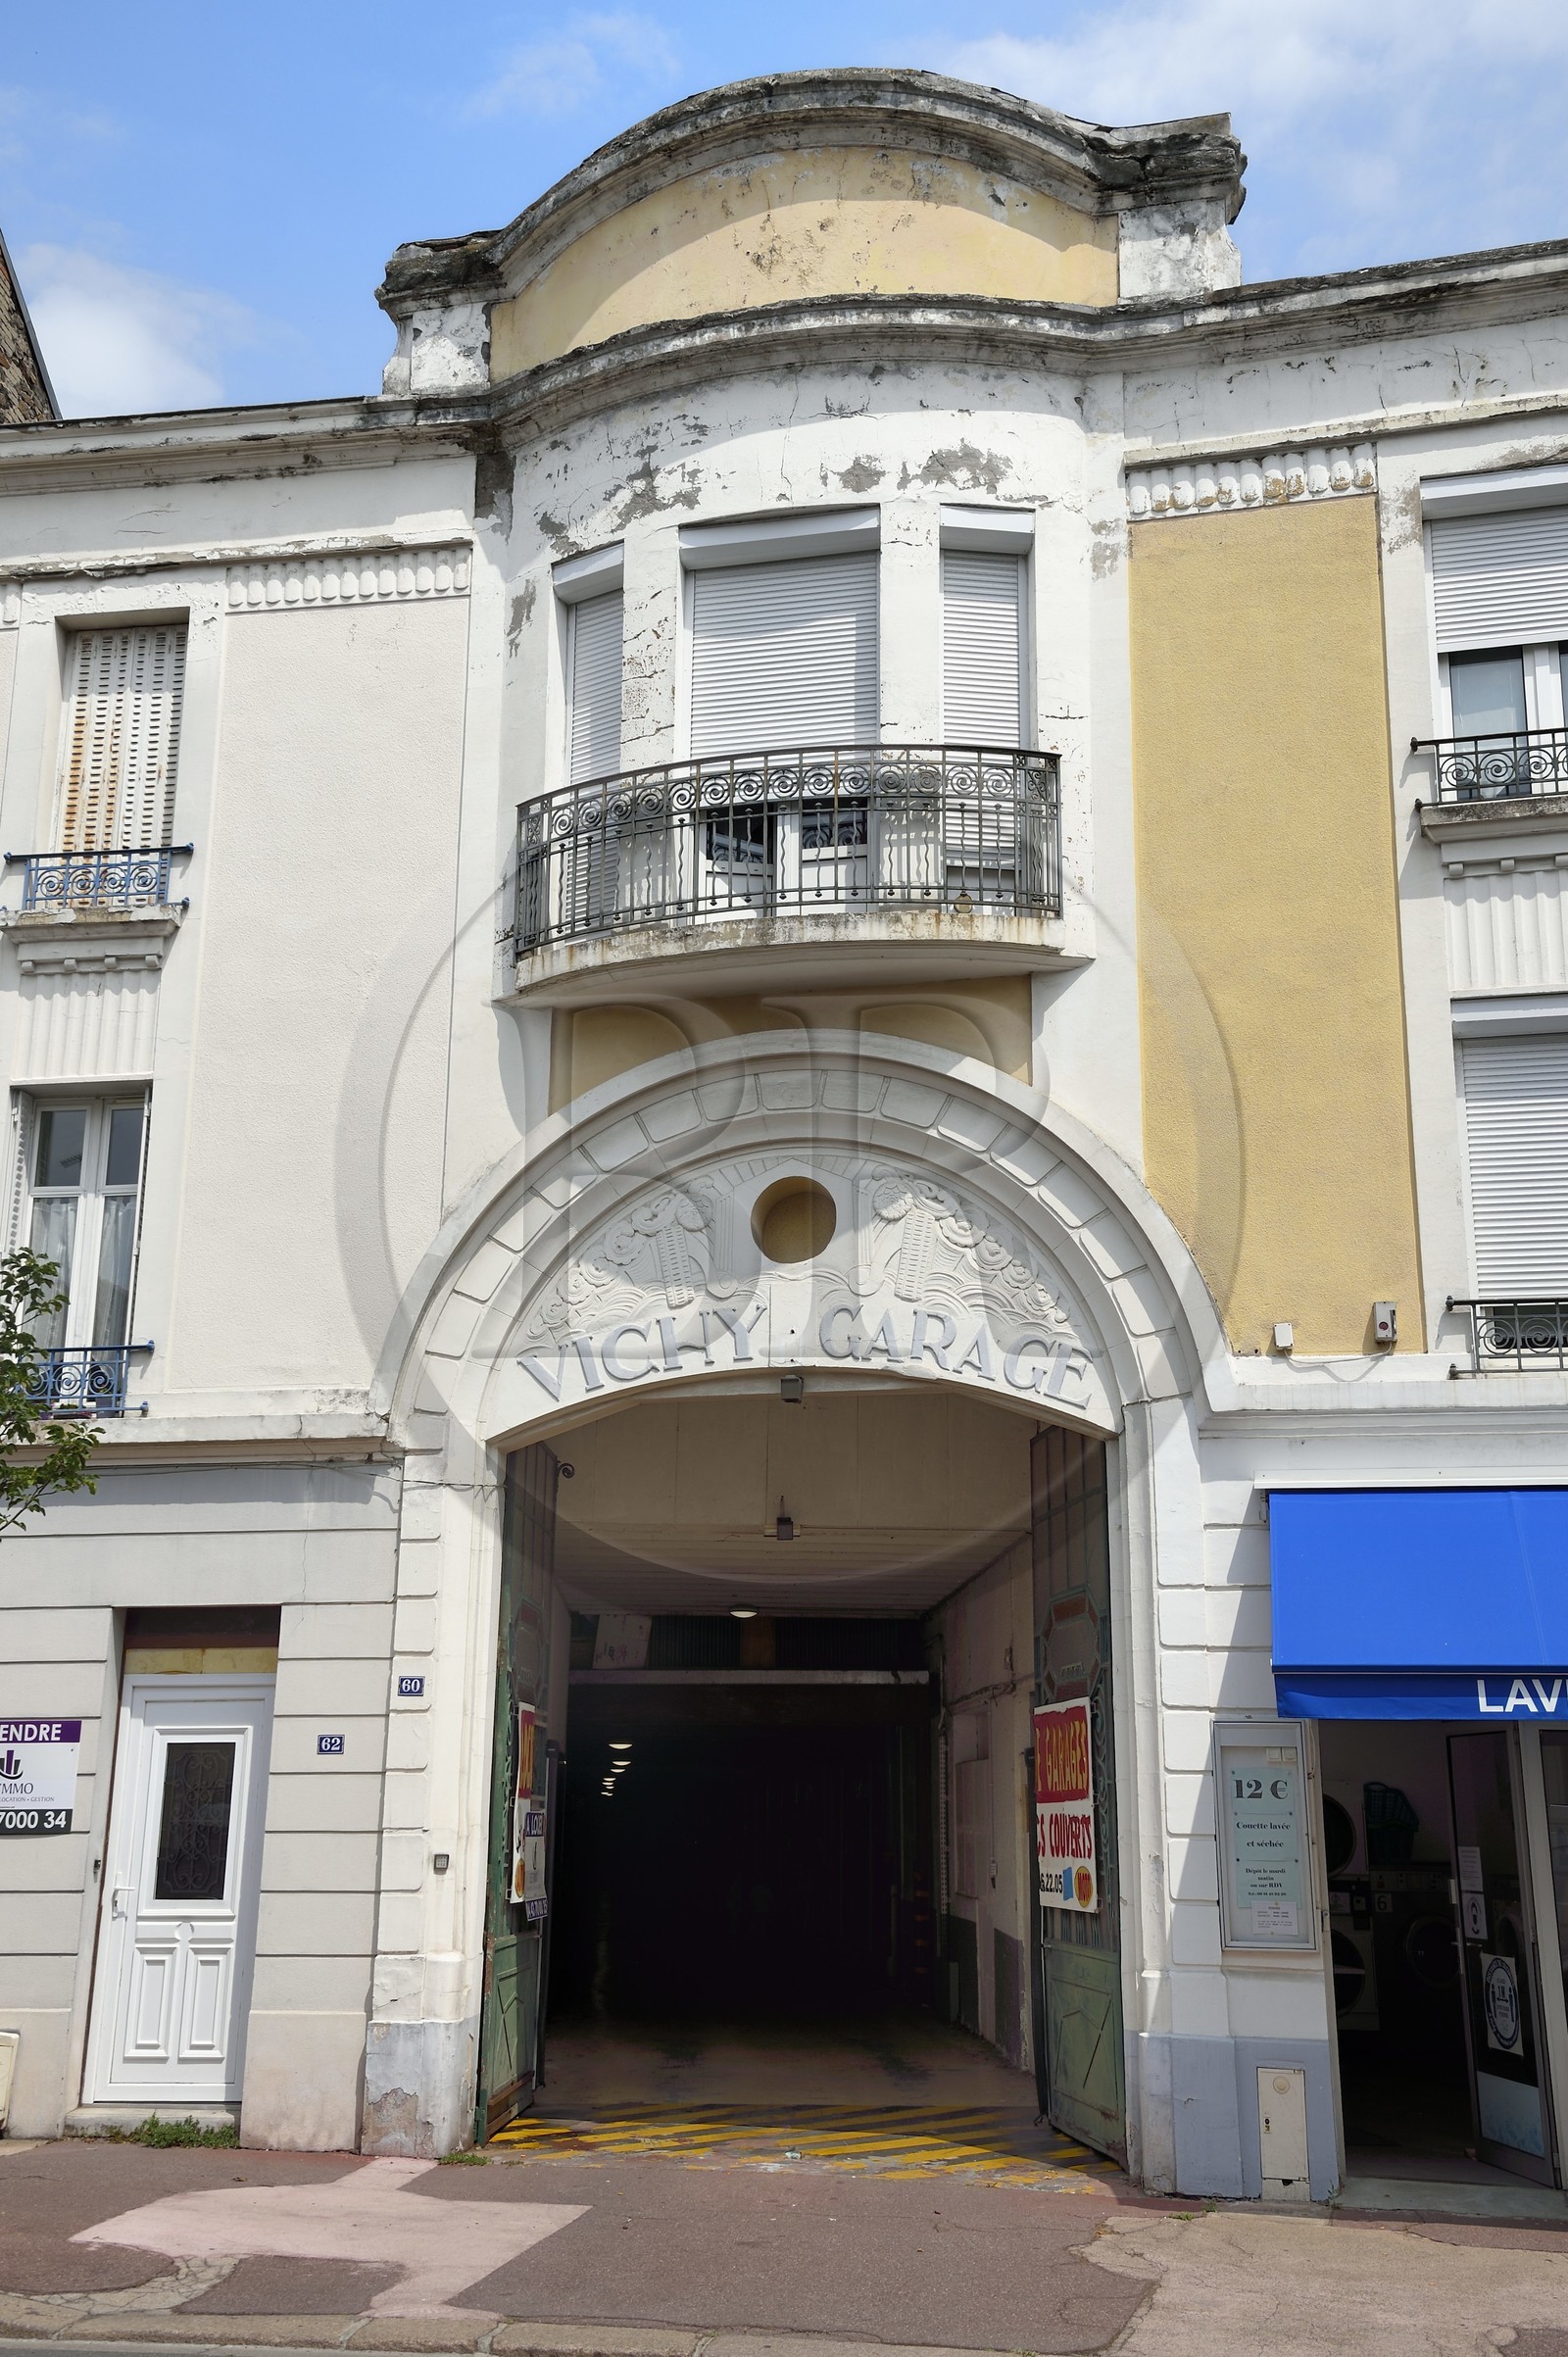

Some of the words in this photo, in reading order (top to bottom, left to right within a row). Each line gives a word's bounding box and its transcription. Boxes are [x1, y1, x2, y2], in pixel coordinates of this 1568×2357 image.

[517, 1303, 768, 1401] VICHY
[819, 1303, 1094, 1409] GARAGE
[401, 1678, 421, 1694] 60
[1477, 1679, 1568, 1713] LAV
[320, 1737, 341, 1751] 62
[0, 1782, 34, 1794] MMO
[1232, 1779, 1263, 1799] 12
[1270, 1779, 1289, 1799] €
[43, 1810, 67, 1830] 34
[1236, 1821, 1268, 1830] Couette
[1269, 1821, 1292, 1831] lavée
[1049, 1813, 1093, 1860] COUVERTS
[1256, 1840, 1285, 1848] séchée
[1377, 1894, 1388, 1911] 6
